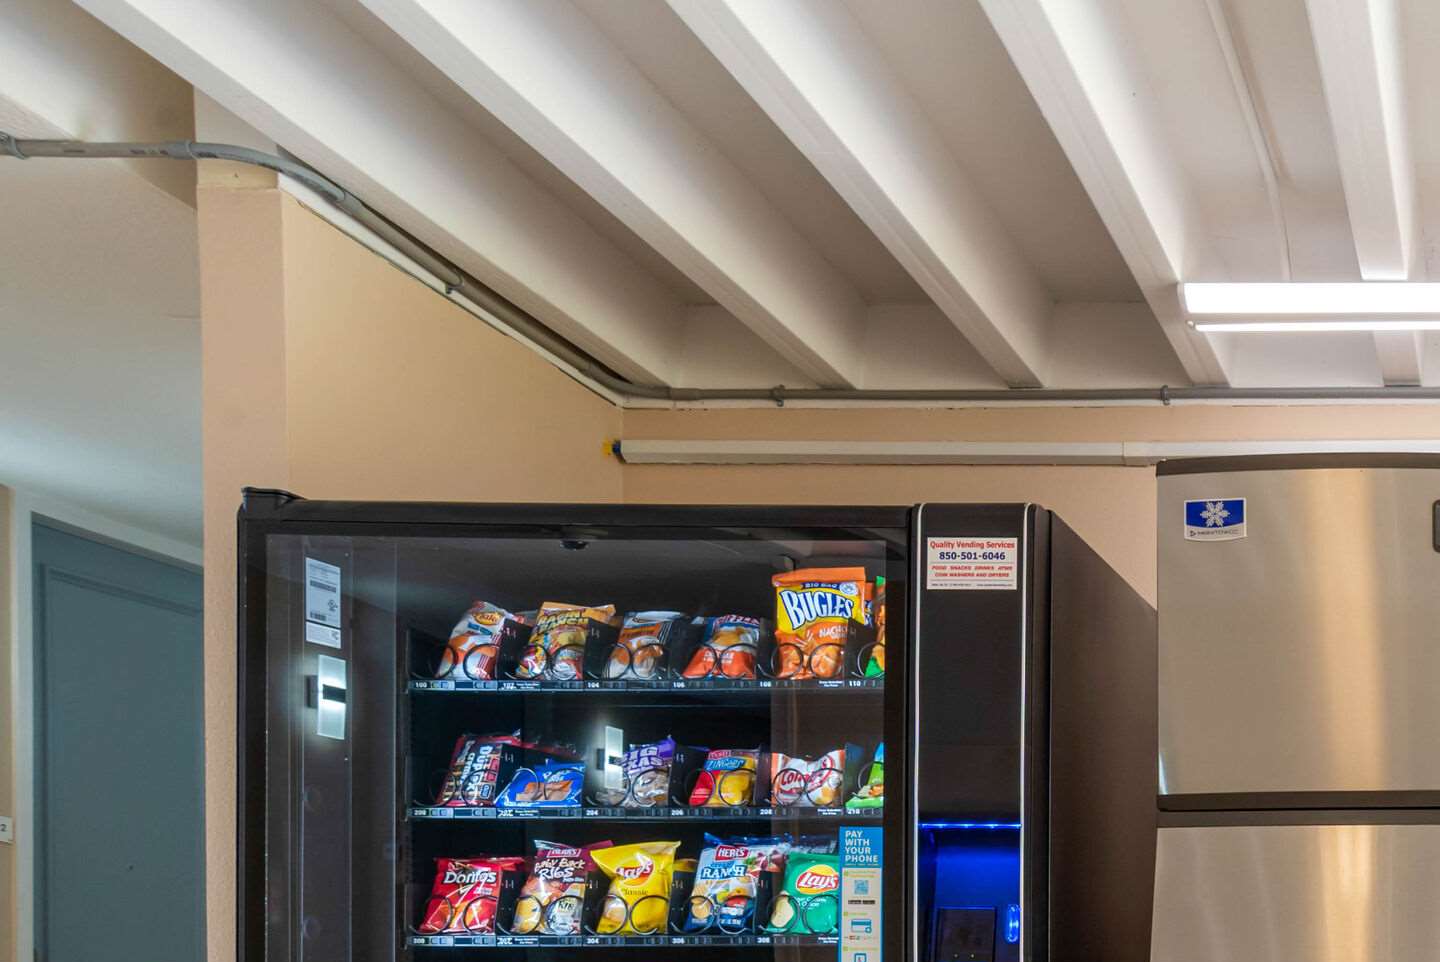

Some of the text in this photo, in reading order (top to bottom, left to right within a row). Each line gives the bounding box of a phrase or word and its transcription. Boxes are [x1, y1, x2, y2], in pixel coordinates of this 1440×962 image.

[930, 541, 1015, 549] Quality Vending Services
[780, 589, 854, 630] BUGLES
[845, 830, 863, 838] PAY
[845, 838, 870, 846] WITH
[845, 855, 879, 863] PHONE
[443, 869, 497, 885] Doritos
